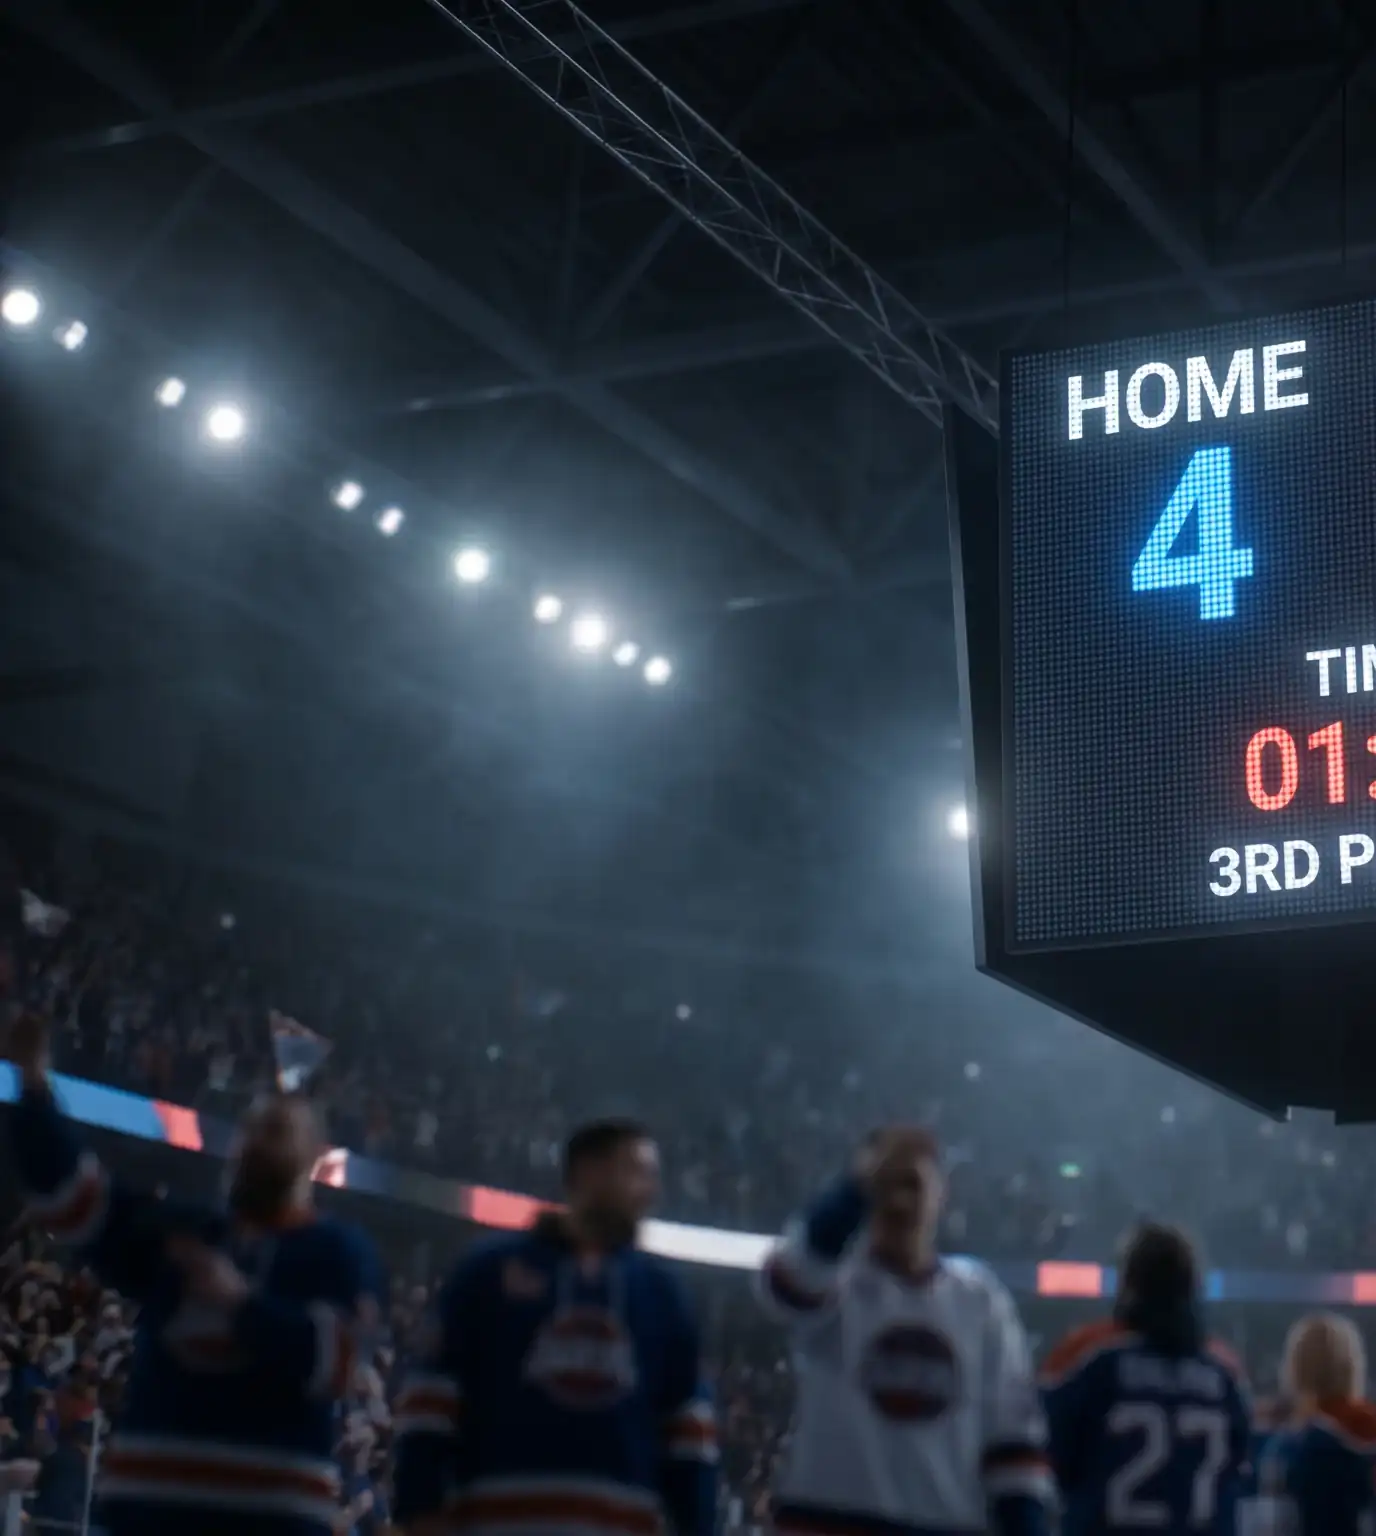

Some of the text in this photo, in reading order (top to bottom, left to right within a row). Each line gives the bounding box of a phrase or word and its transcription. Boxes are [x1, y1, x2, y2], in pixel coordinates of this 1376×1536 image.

[1067, 340, 1309, 439] HOME
[1132, 446, 1254, 620] 4
[1208, 839, 1320, 897] 3RD
[1104, 1401, 1232, 1530] 27
